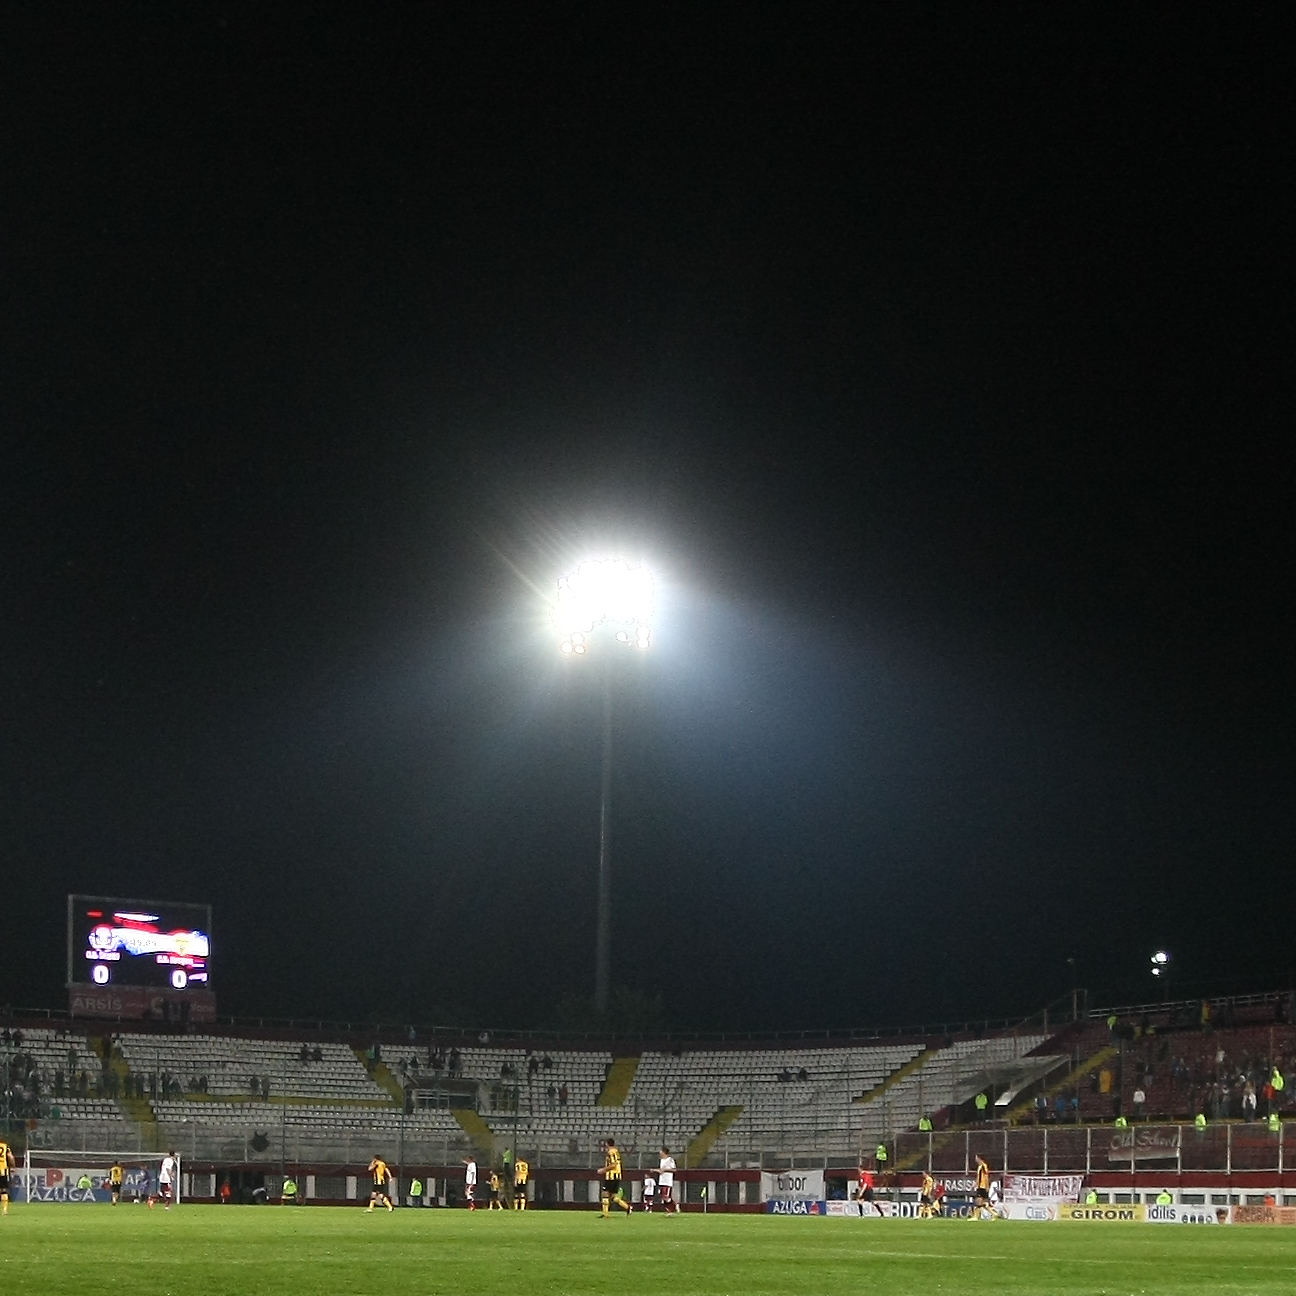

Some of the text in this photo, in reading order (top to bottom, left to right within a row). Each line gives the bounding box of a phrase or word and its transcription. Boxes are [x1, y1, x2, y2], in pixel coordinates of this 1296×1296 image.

[93, 964, 109, 984] 0
[172, 969, 187, 988] 0
[30, 1187, 96, 1201] AZUGA
[773, 1200, 808, 1214] AZUGA
[1148, 1205, 1177, 1220] idilis
[1071, 1210, 1133, 1219] GIROM
